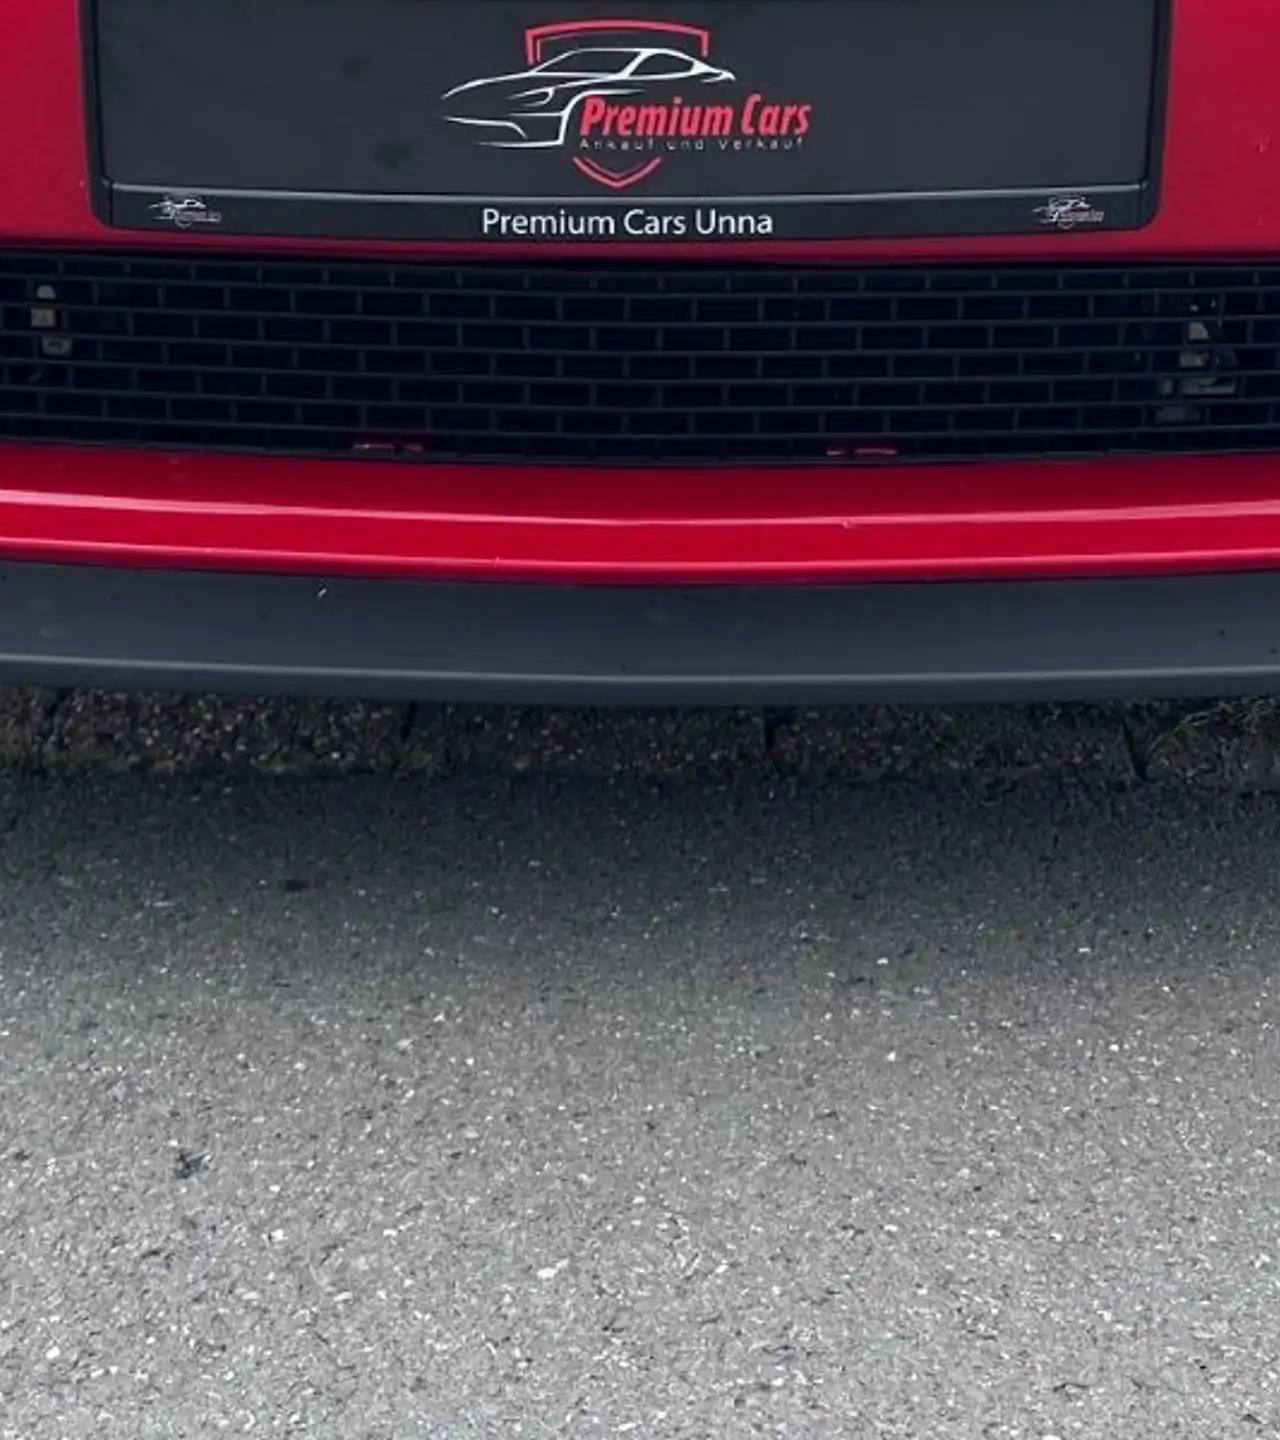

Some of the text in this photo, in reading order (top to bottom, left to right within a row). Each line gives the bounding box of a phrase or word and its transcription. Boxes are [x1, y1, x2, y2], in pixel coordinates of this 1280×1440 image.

[580, 93, 812, 136] Premium Cars
[579, 138, 655, 151] Ankauf
[666, 138, 704, 151] und
[482, 208, 774, 235] Premium Cars Unna
